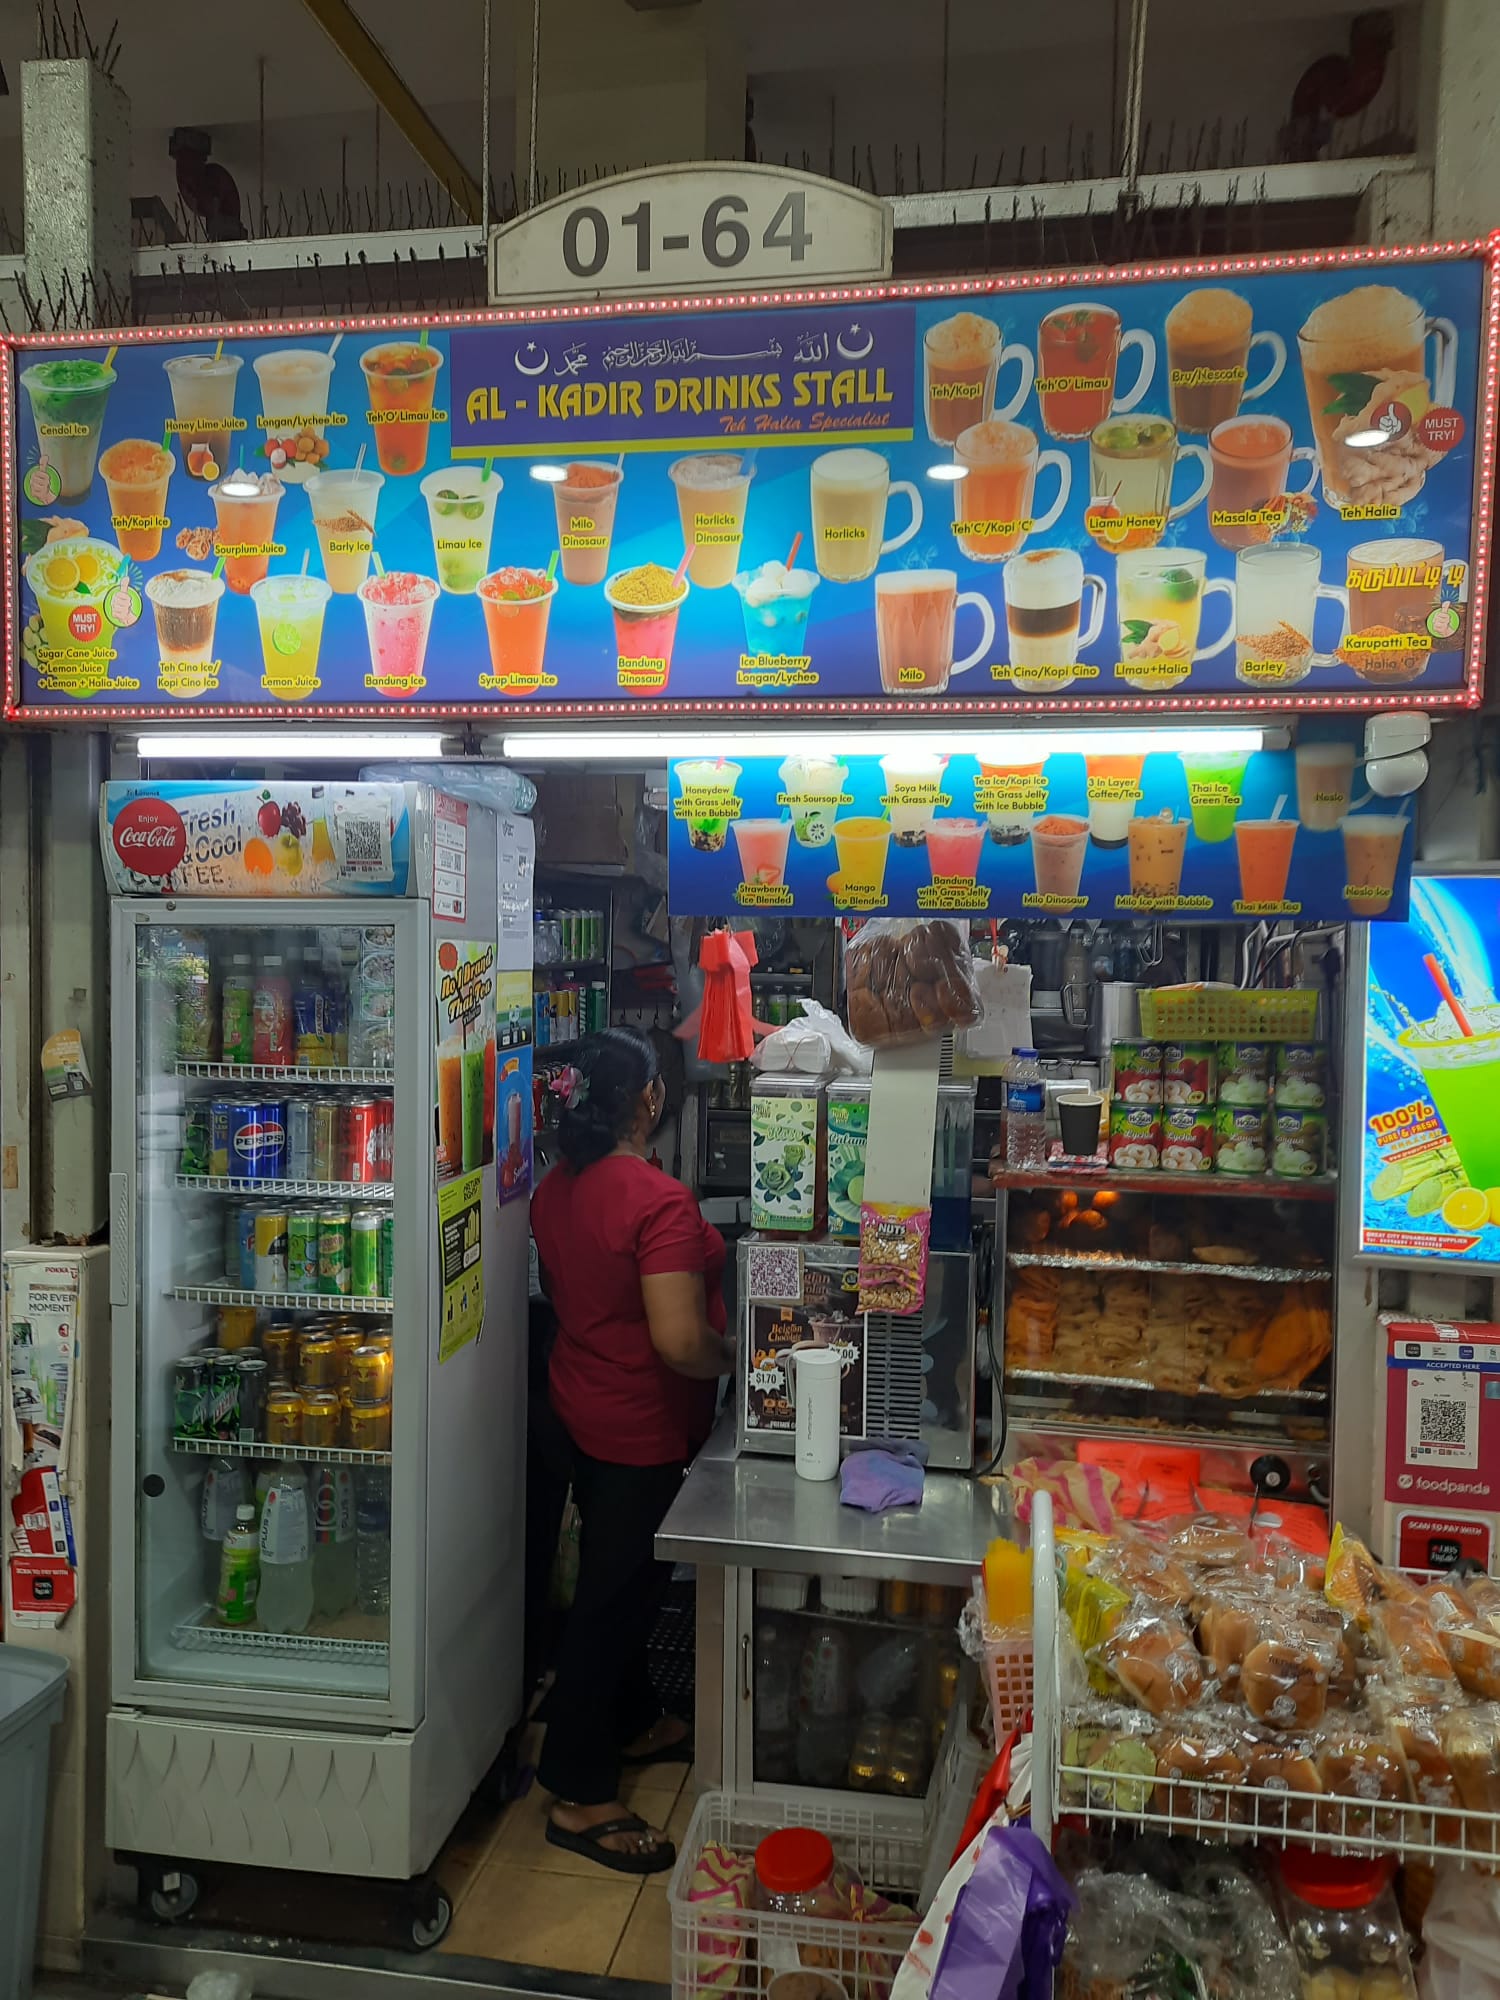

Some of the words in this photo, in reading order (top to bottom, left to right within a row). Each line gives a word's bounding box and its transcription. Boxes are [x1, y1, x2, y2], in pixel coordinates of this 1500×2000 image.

[562, 191, 813, 277] 01-64
[1171, 368, 1244, 384] Bru/Nescafe
[1075, 378, 1108, 389] Limau
[466, 386, 507, 424] AL
[515, 399, 527, 409] -
[538, 380, 643, 421] KADIR
[655, 373, 782, 415] DRINKS
[793, 367, 894, 408] STALL
[931, 385, 980, 397] Teh/Kopi
[400, 411, 429, 420] Limau
[431, 411, 445, 420] Ice
[166, 420, 194, 432] Honey
[197, 420, 218, 430] Lime
[221, 419, 245, 429] Juice
[257, 415, 330, 428] Longan/Lychee
[331, 415, 346, 424] Ice
[720, 415, 746, 433] Teh
[754, 414, 802, 431] Halia
[809, 411, 891, 432] Specialist
[1425, 418, 1459, 429] MUST
[40, 425, 71, 435] Cendol
[73, 425, 87, 434] Ice
[1427, 430, 1455, 441] TRY!
[1213, 512, 1257, 524] Masala
[1260, 511, 1281, 522] Tea
[1341, 507, 1361, 518] Teh
[1365, 506, 1397, 517] Halia
[112, 517, 153, 529] Teh/Kopi
[154, 518, 168, 527] Ice
[571, 519, 593, 529] Milo
[695, 515, 735, 525] Horlicks
[1089, 518, 1123, 528] Liamu
[1126, 516, 1161, 530] Honey
[695, 532, 741, 542] Dinosaur
[825, 528, 865, 539] Horlicks
[437, 541, 466, 550] Limau
[469, 540, 482, 549] Ice
[562, 536, 607, 546] Dinosaur
[215, 544, 257, 557] Sourplum
[260, 543, 284, 553] Juice
[330, 542, 355, 553] Barly
[357, 542, 370, 551] Ice
[72, 613, 97, 623] MUST
[75, 623, 96, 633] TRY!
[1345, 637, 1404, 650] Karupatti
[1407, 637, 1428, 648] Tea
[38, 649, 63, 660] Sugar
[66, 649, 90, 658] Cane
[92, 649, 115, 658] Juice
[618, 658, 663, 671] Bandung
[741, 656, 755, 666] Ice
[758, 656, 809, 667] Blueberry
[47, 664, 78, 673] Lemon
[80, 664, 102, 673] Juice
[160, 663, 176, 672] Teh
[178, 663, 198, 672] Cino
[992, 667, 1010, 678] Teh
[1013, 666, 1068, 679] Cino/Kopi
[1072, 666, 1097, 676] Cino
[1245, 662, 1282, 674] Barley
[618, 674, 664, 684] Dinosaur
[737, 671, 817, 684] Longan/Lychee
[900, 670, 923, 680] Milo
[47, 679, 77, 688] Lemon
[88, 679, 112, 688] Halia
[114, 679, 138, 688] Juice
[158, 678, 178, 689] Kopi
[180, 678, 201, 688] Cino
[203, 679, 217, 687] Ice
[262, 677, 293, 687] Lemon
[295, 677, 319, 687] Juice
[366, 676, 408, 688] Bandung
[410, 676, 424, 686] Ice
[480, 675, 507, 688] Syrup
[510, 675, 539, 684] Limau
[541, 675, 555, 684] Ice
[974, 777, 990, 786] Tea
[992, 777, 1031, 787] Ice/Kopi
[1034, 777, 1046, 785] Ice
[685, 785, 730, 796] Honeydew
[895, 784, 916, 794] Soya
[919, 784, 936, 792] Milk
[1192, 784, 1211, 792] Thai
[1214, 784, 1229, 792] Ice
[675, 799, 693, 807] with
[695, 799, 719, 807] Grass
[720, 798, 741, 809] Jelly
[778, 795, 801, 803] Fresh
[803, 795, 838, 805] Soursop
[839, 795, 852, 803] Ice
[1191, 796, 1221, 804] Green
[1223, 796, 1240, 804] Tea
[675, 809, 693, 817] with
[695, 809, 707, 817] Ice
[709, 809, 738, 817] Bubble
[138, 815, 158, 823] Enjoy
[195, 825, 242, 863] Cool
[934, 877, 974, 887] Bandung
[740, 885, 787, 896] Strawberry
[742, 896, 754, 904] Ice
[756, 896, 792, 904] Blended
[441, 975, 456, 1001] No
[463, 945, 493, 983] Brand
[448, 986, 474, 1024] Thai
[474, 978, 492, 1003] Tea
[1371, 1101, 1434, 1133] 100%
[1377, 1132, 1400, 1146] PURE
[1400, 1128, 1411, 1139] &
[1411, 1118, 1438, 1134] FRESH
[878, 1223, 906, 1235] NUTS
[29, 1293, 48, 1301] FOR
[771, 1323, 802, 1334] Belgian
[767, 1331, 802, 1342] Chocolate
[1426, 1362, 1461, 1370] ACCEPTED
[756, 1373, 777, 1384] $1.70
[1416, 1475, 1490, 1495] foodpanda
[1408, 1521, 1431, 1530] SCAN
[1432, 1523, 1443, 1531] TO
[1443, 1525, 1460, 1533] PAY
[1460, 1526, 1482, 1536] WITH
